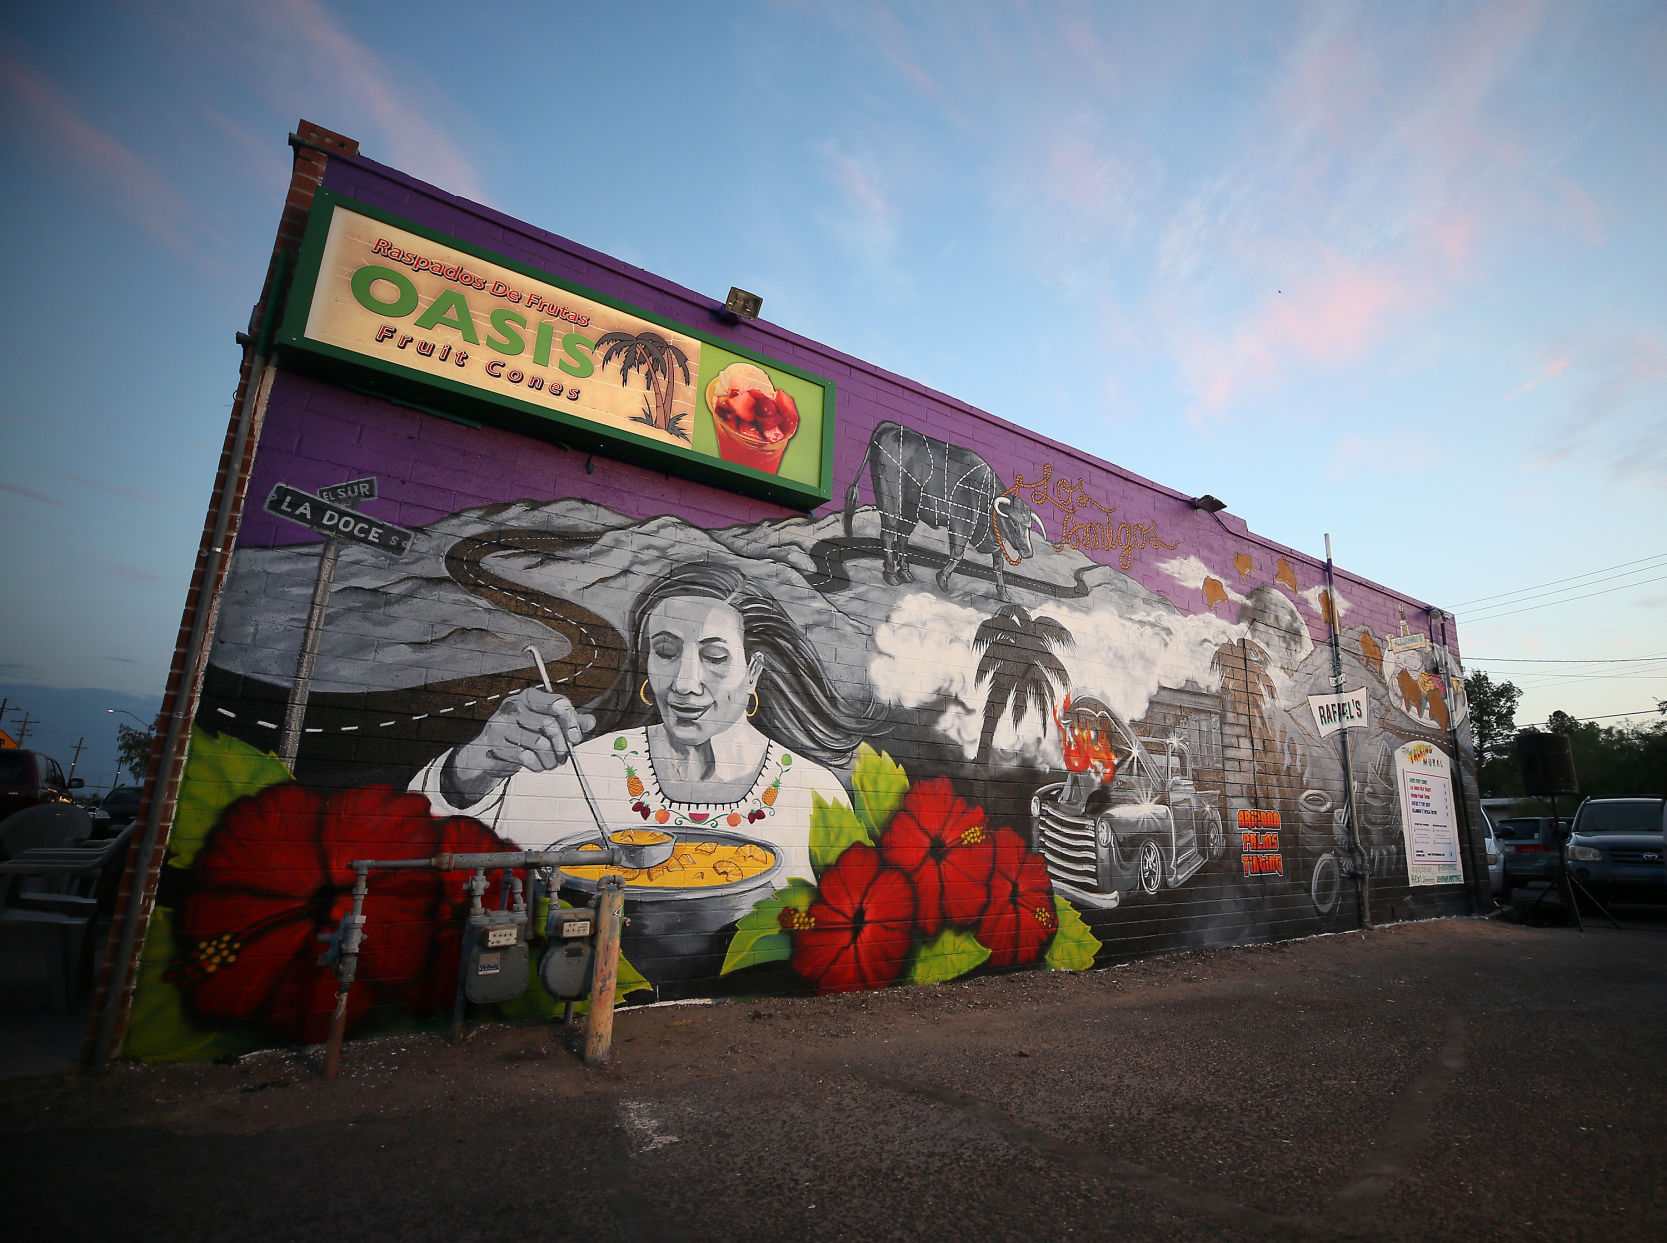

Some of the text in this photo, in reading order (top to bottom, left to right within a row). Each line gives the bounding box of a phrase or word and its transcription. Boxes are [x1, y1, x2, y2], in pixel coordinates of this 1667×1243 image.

[371, 238, 591, 327] Raspados De Frutas
[350, 265, 595, 379] OASIS
[375, 324, 580, 401] Fruit Cones
[280, 495, 311, 520] LA
[322, 509, 384, 543] DOCE
[322, 483, 370, 501] EL SUR
[1052, 514, 1180, 570] Amigos
